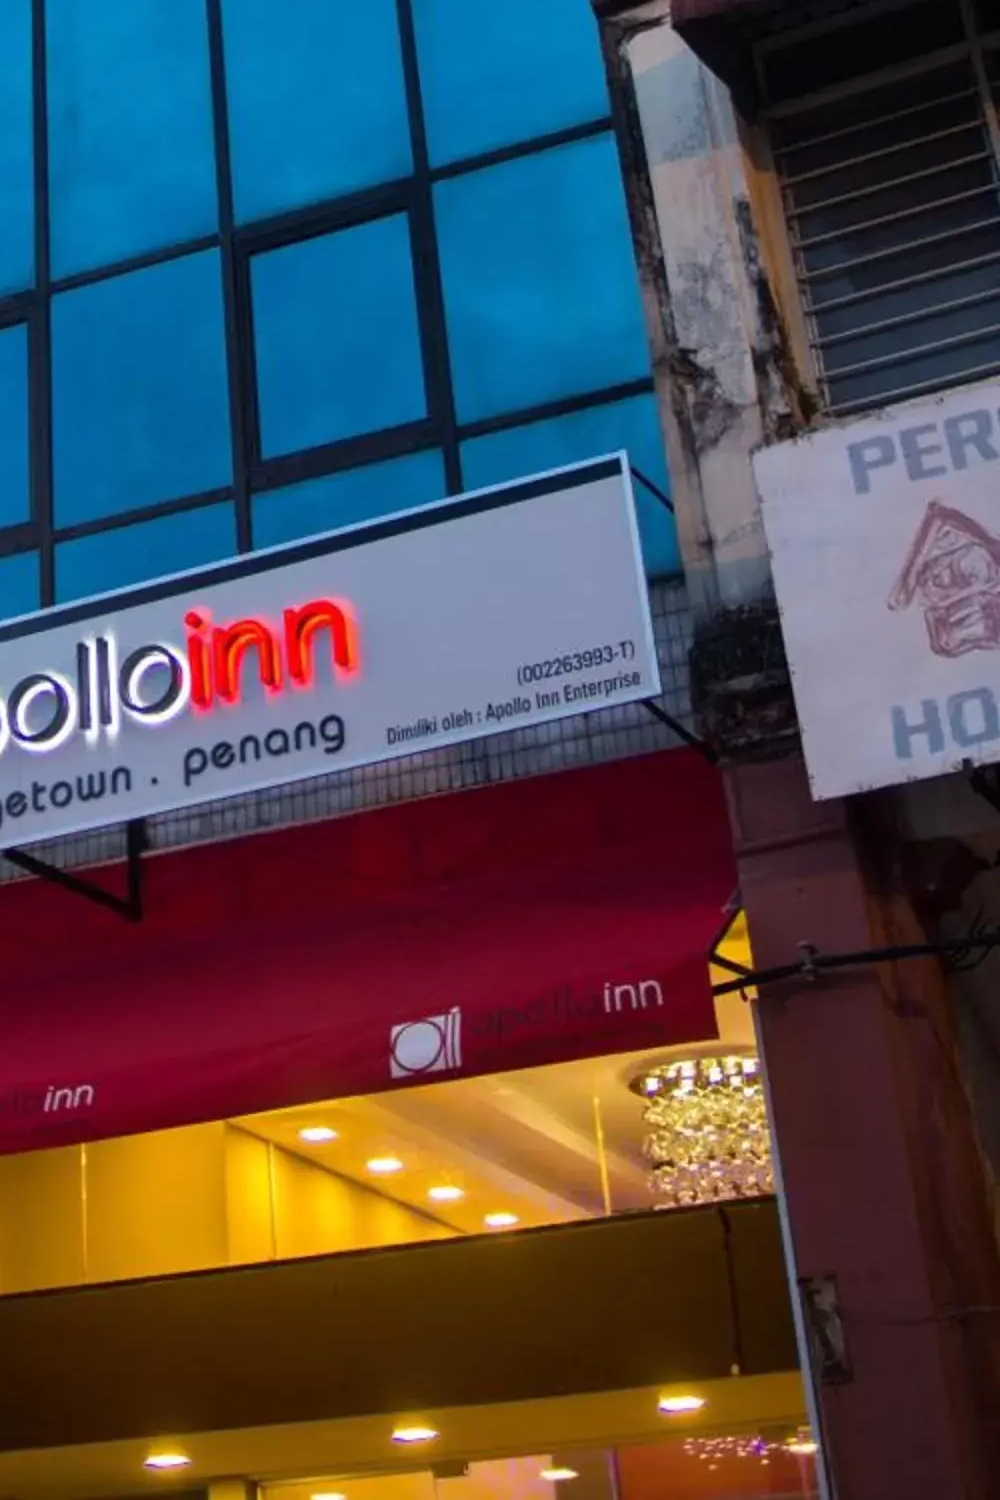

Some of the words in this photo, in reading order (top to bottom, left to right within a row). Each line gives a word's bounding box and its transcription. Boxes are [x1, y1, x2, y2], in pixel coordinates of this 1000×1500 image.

[847, 406, 1000, 496] PER
[517, 639, 636, 686] (002263993-T)
[442, 708, 473, 732] oleh
[485, 697, 532, 722] Apollo
[535, 690, 561, 710] Inn
[563, 670, 641, 704] Enterprise
[183, 713, 347, 786] penang
